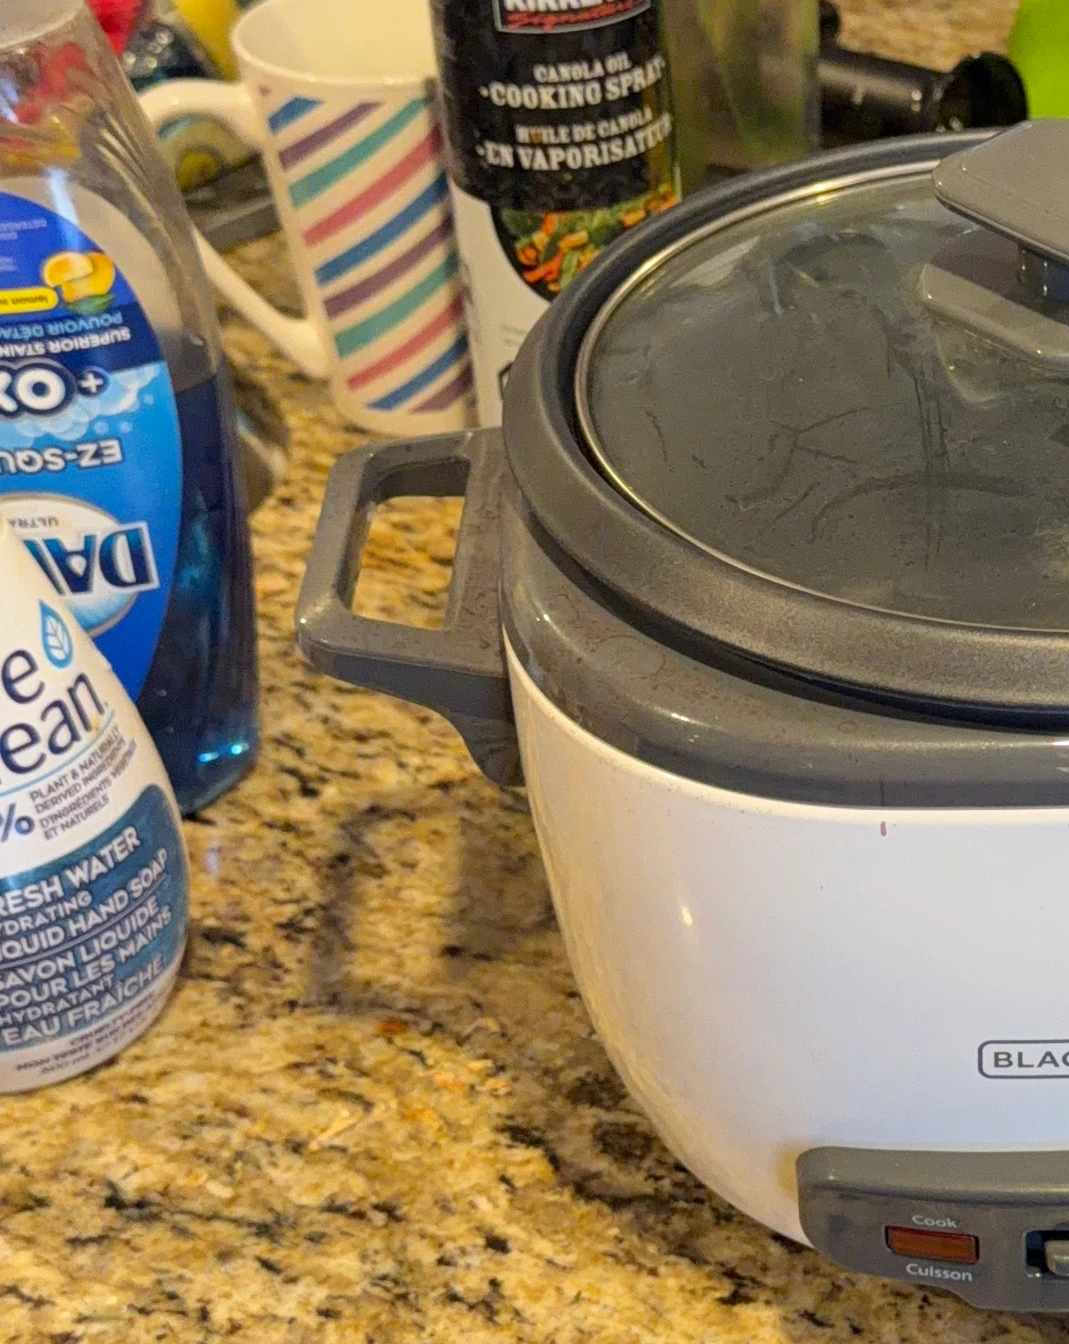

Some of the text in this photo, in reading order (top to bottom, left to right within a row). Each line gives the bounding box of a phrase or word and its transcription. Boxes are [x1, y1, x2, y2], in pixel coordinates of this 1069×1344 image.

[487, 55, 664, 110] COOKING SPRAY
[533, 50, 633, 84] CANOLA OIL
[514, 106, 654, 145] HUILE DE CANOLA
[484, 139, 515, 169] EN
[48, 311, 124, 337] POUVOIR
[48, 327, 132, 355] SUPERIOR
[0, 438, 124, 474] EZ-SQU
[22, 524, 157, 596] DA
[0, 672, 106, 775] ean
[29, 773, 70, 802] PLANT
[34, 781, 82, 814] DERIVED
[43, 826, 60, 841] ET
[60, 793, 111, 833] NATURELS
[0, 826, 142, 916] RESH WATER
[68, 890, 130, 938] HAND
[129, 847, 169, 899] SOAP
[72, 953, 116, 989] LES
[118, 904, 172, 964] MAINS
[80, 894, 160, 963] LIQUIDE
[0, 972, 115, 1028] HYDRATANT
[3, 1016, 61, 1048] EAU
[911, 1213, 958, 1229] Cook
[905, 1262, 973, 1282] Cuisson
